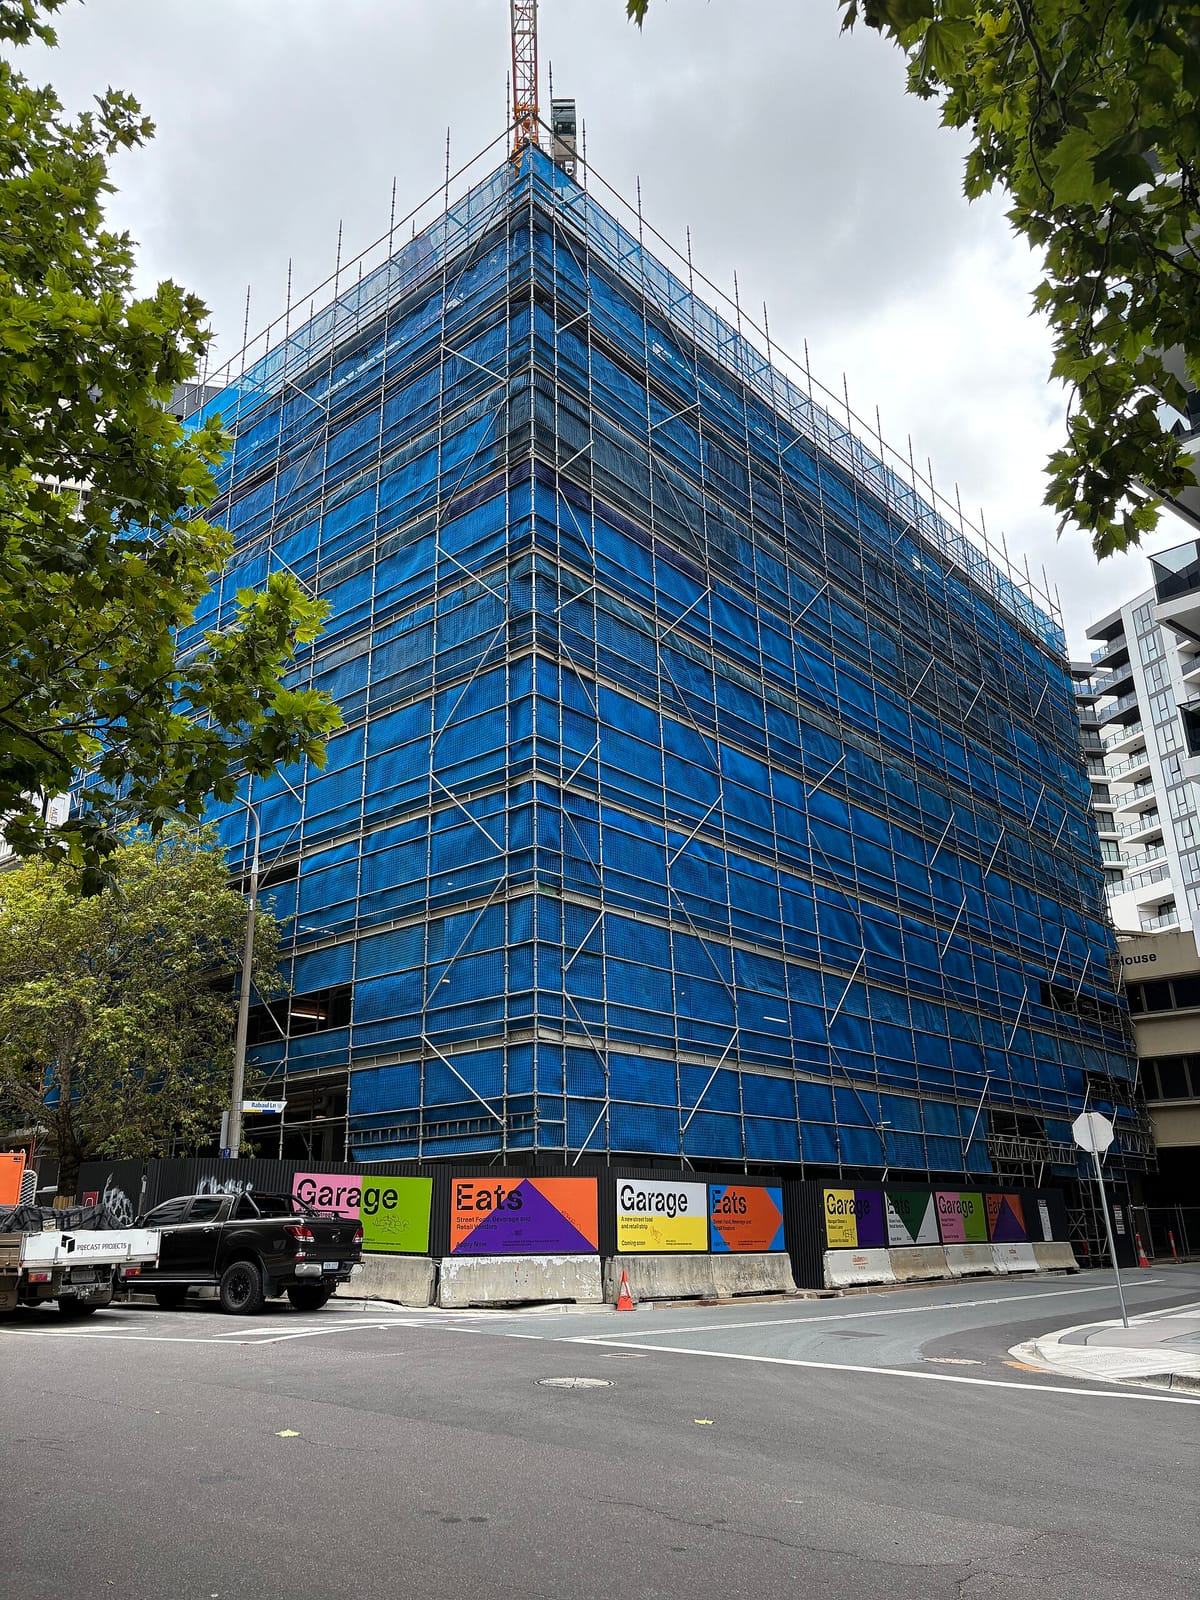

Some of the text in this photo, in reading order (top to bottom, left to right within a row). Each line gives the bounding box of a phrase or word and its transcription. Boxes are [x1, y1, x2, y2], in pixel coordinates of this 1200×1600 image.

[297, 1179, 398, 1215] Garage
[457, 1183, 523, 1211] Eats
[620, 1184, 688, 1218] Garage
[712, 1190, 747, 1214] Eats
[827, 1193, 870, 1219] Garage
[887, 1194, 911, 1214] Eats
[939, 1196, 974, 1218] Garage
[987, 1197, 1004, 1214] Eat
[77, 1242, 127, 1251] PRECAST PROJECTS
